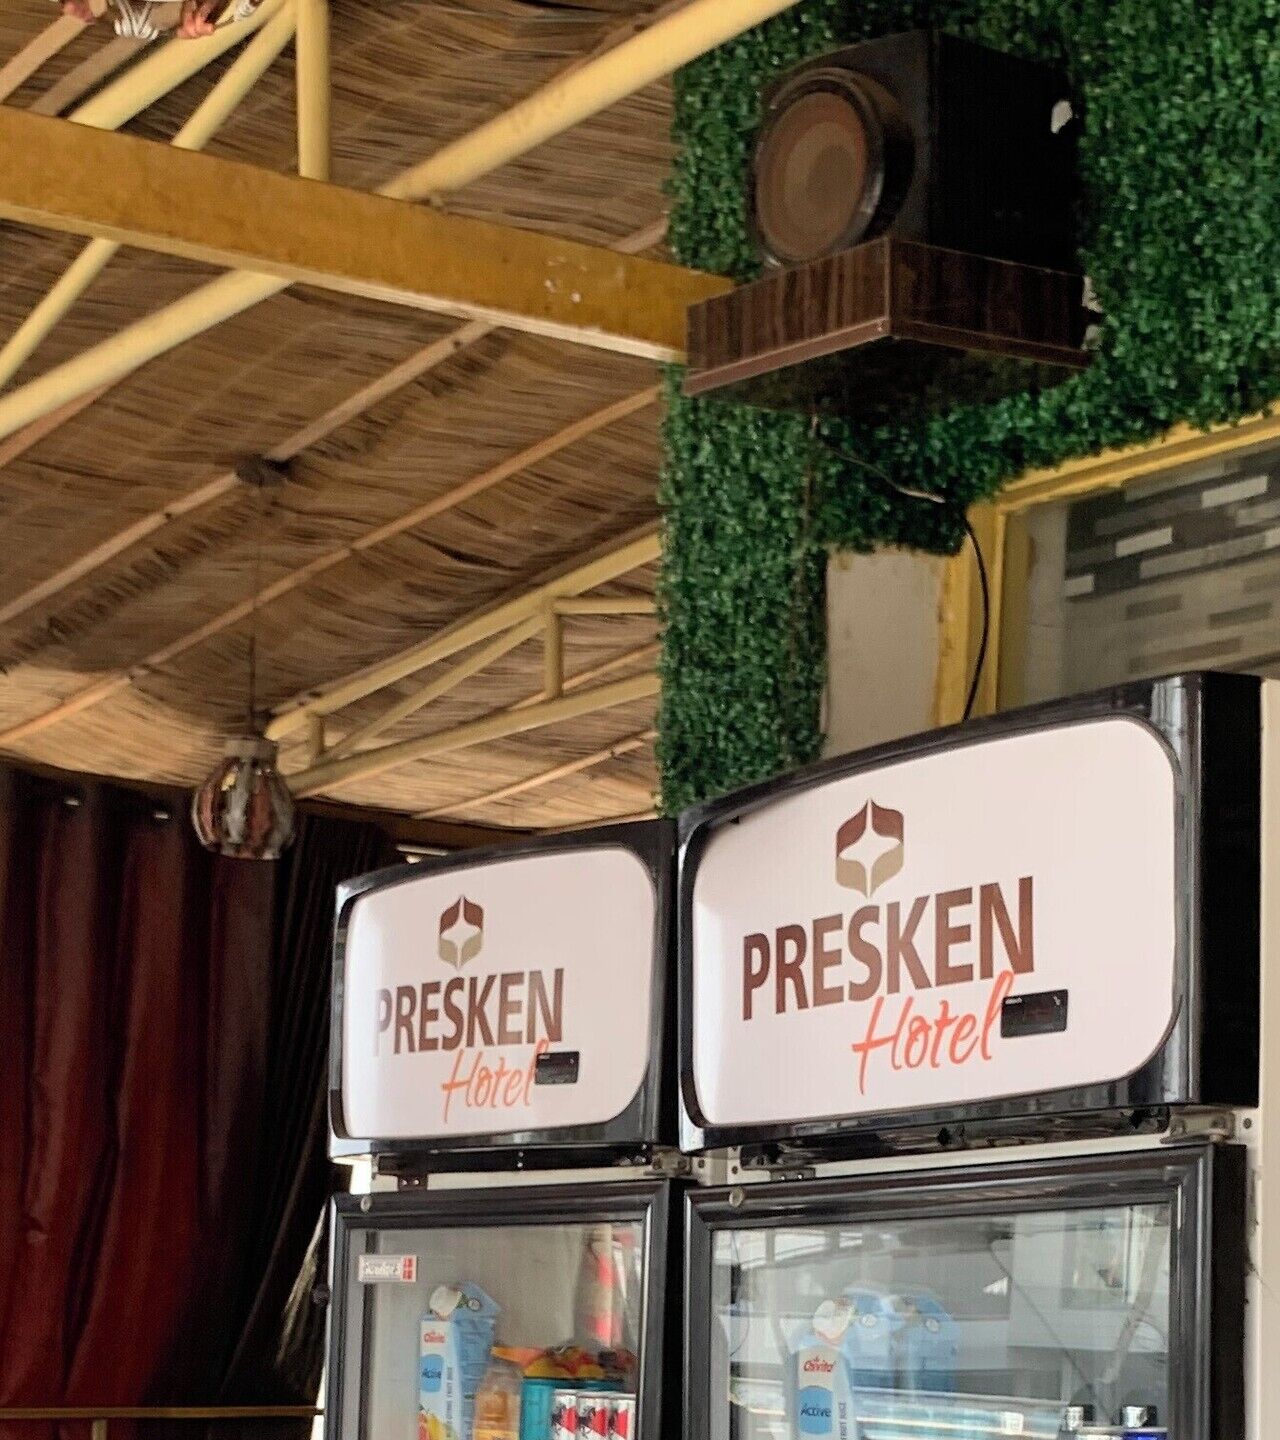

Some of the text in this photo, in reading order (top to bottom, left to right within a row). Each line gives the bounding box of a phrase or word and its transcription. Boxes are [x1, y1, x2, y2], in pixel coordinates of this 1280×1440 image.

[742, 876, 1035, 1021] PRESKEN
[374, 968, 564, 1056] PRESKEN
[851, 969, 1015, 1096] Hotel
[441, 1039, 549, 1123] Hotel
